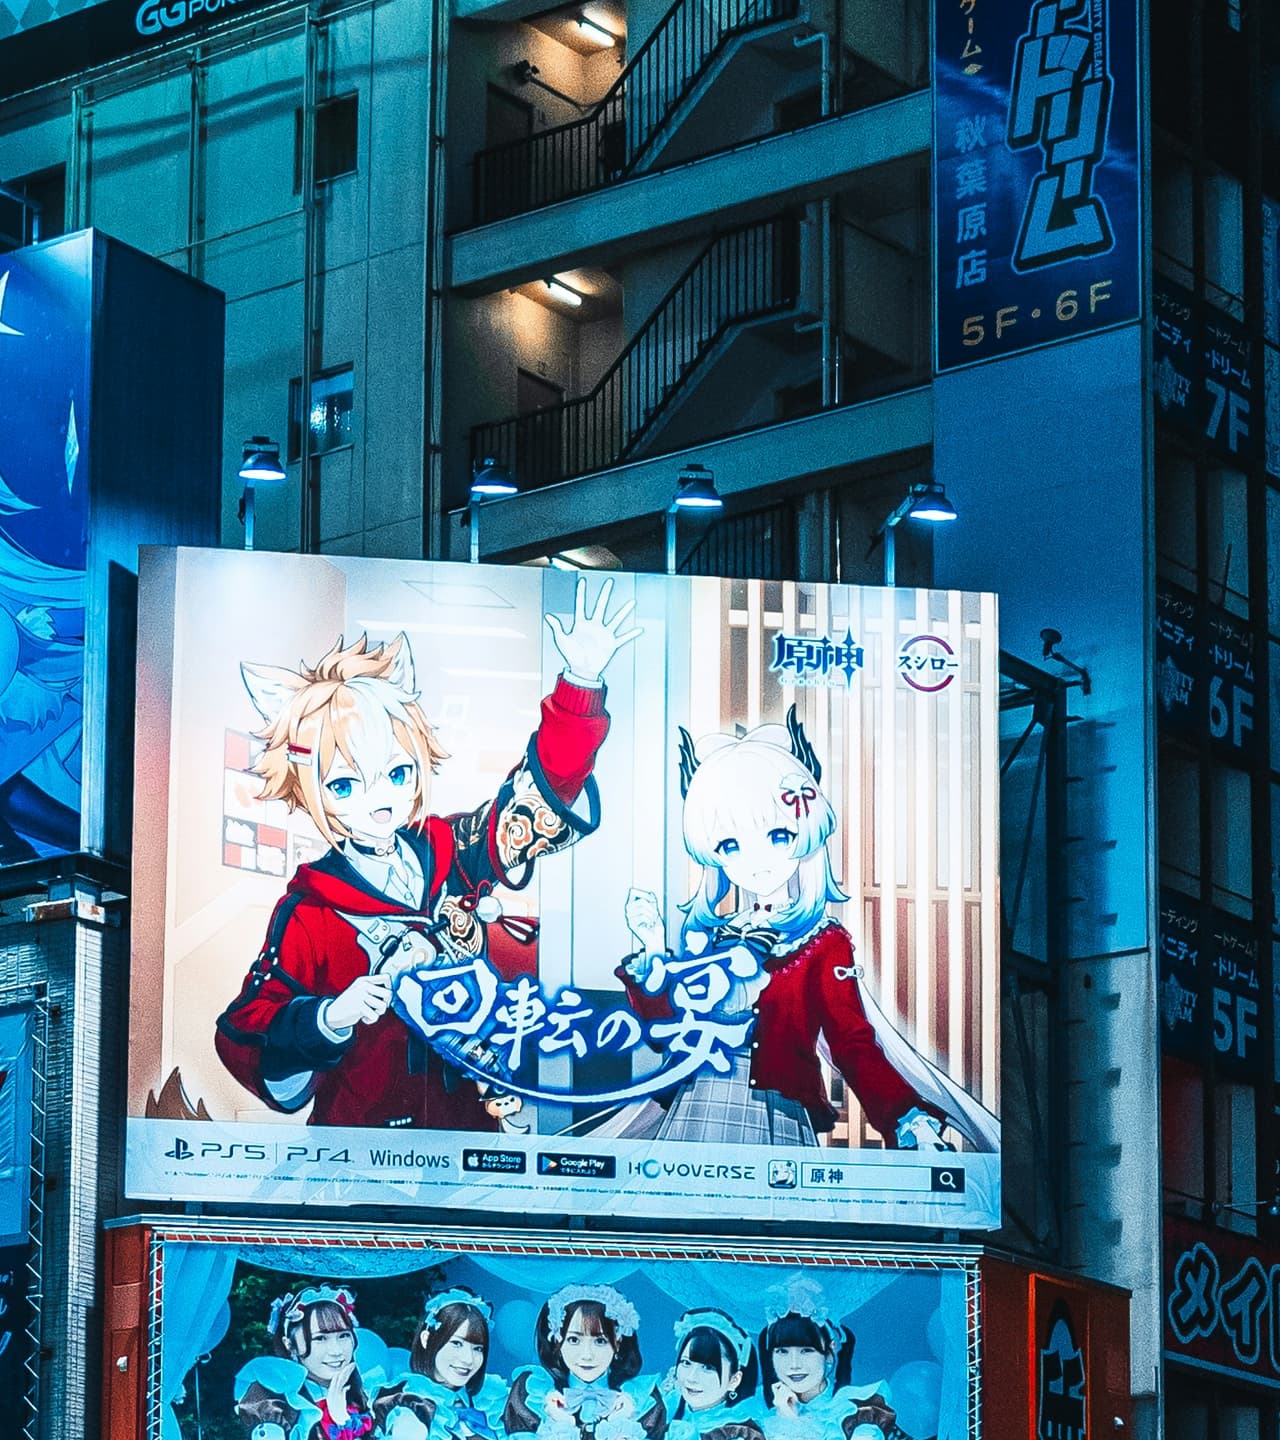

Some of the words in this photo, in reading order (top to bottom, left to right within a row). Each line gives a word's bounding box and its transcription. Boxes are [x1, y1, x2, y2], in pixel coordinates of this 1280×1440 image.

[954, 115, 987, 291] 秋葉原店
[1205, 376, 1251, 454] 7F
[772, 628, 864, 682] 原神
[897, 655, 959, 671] スシロー
[1208, 695, 1255, 750] 6F
[398, 942, 758, 1080] 回転の宴
[1212, 985, 1259, 1060] 5F
[200, 1143, 265, 1160] PS5
[287, 1147, 352, 1164] PS4
[369, 1148, 450, 1169] Windows
[560, 1157, 588, 1170] Google
[589, 1161, 606, 1172] Play
[810, 1167, 844, 1184] 原神
